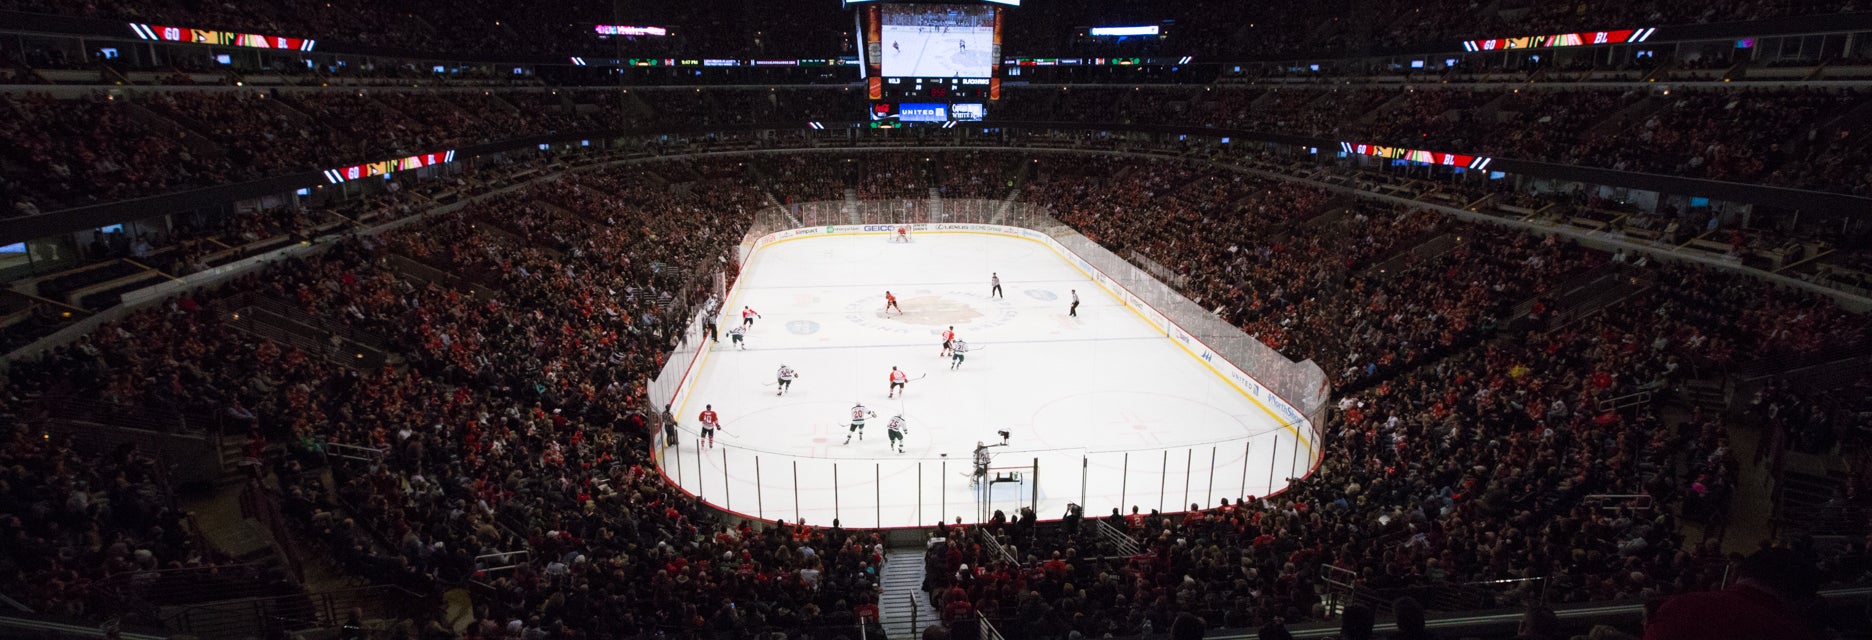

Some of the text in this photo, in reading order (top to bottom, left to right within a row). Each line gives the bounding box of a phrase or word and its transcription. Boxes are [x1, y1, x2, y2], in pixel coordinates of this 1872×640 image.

[164, 27, 180, 41] GO
[1594, 32, 1608, 43] BL
[1483, 39, 1496, 50] GO
[1357, 144, 1367, 154] GO
[1443, 153, 1455, 165] BL
[347, 166, 360, 180] GO
[1231, 371, 1253, 390] UNITED
[853, 409, 863, 419] 20
